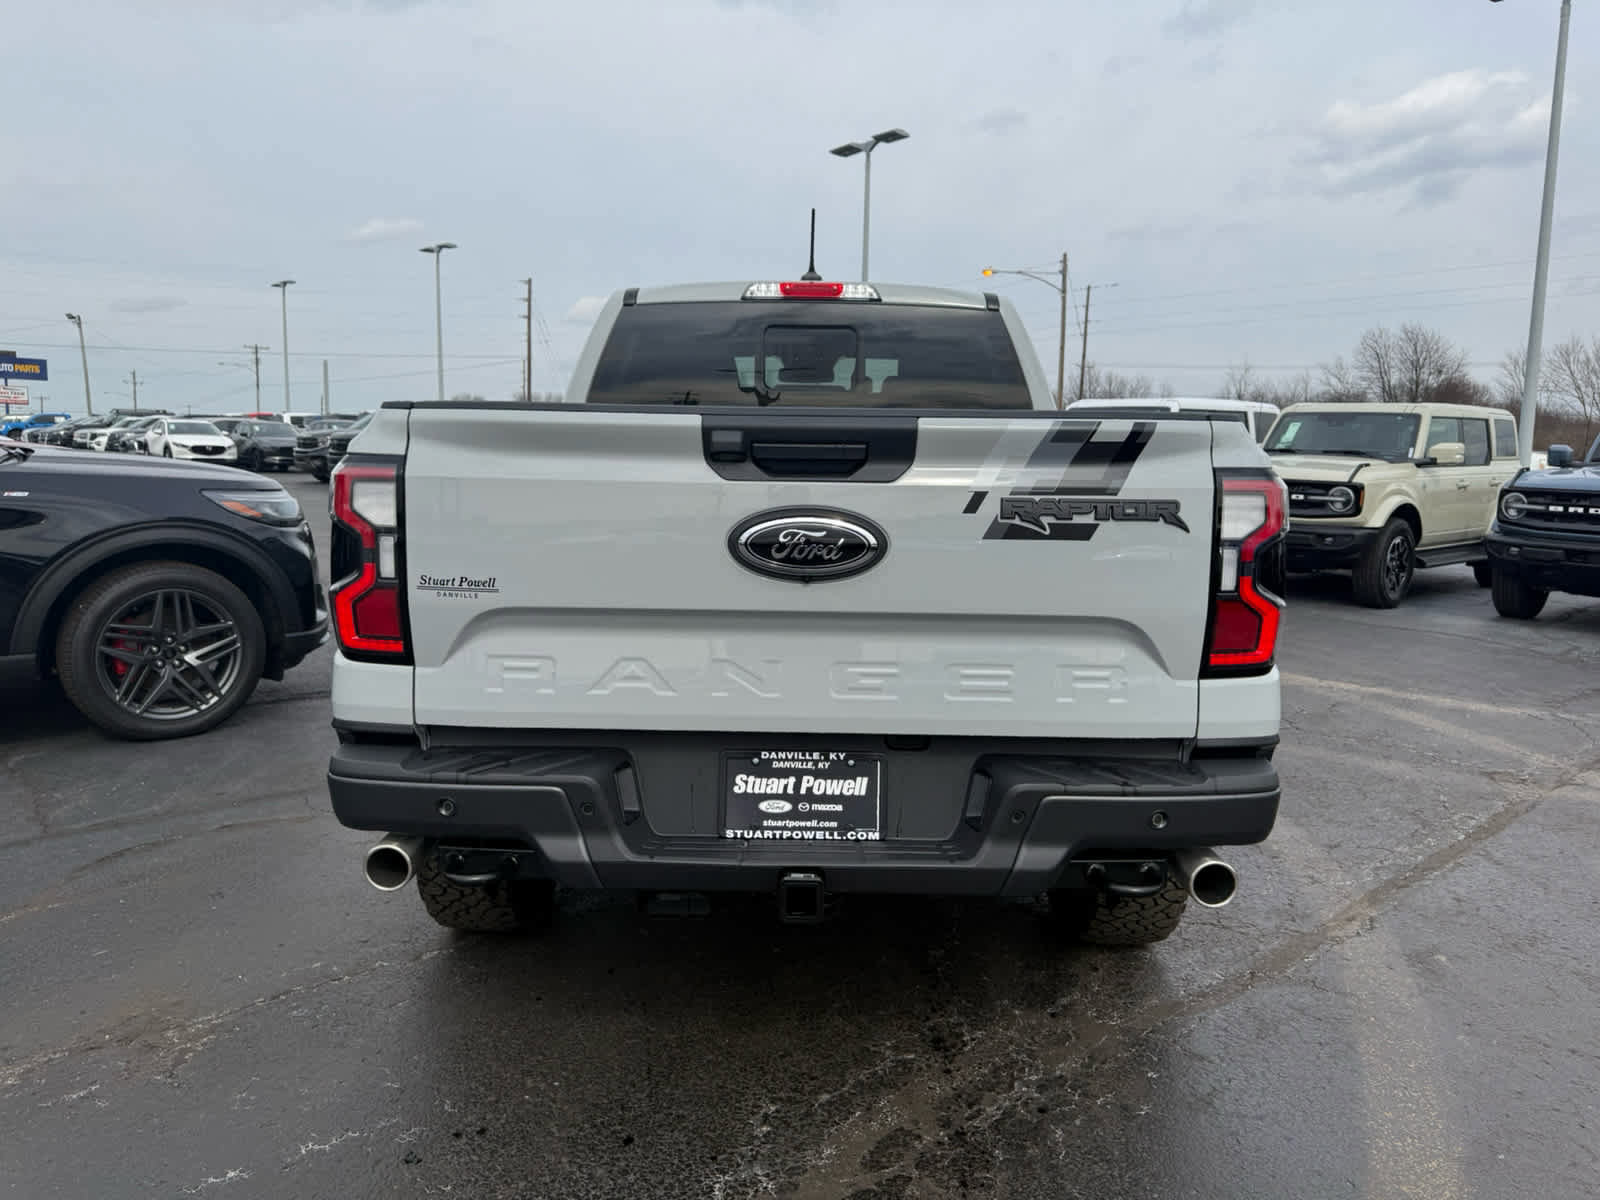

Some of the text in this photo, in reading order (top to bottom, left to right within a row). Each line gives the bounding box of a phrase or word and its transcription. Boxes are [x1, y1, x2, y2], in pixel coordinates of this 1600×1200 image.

[0, 363, 40, 373] UTO PARTS
[1000, 497, 1190, 533] RAPTOR
[771, 528, 845, 561] Ford
[419, 575, 497, 588] Stuart Powell
[436, 591, 479, 600] DANVILLE
[484, 653, 1128, 702] RANGER
[760, 751, 846, 761] DANVILLE, KY
[772, 761, 831, 770] DANVILLE, KY
[733, 773, 869, 796] Stuart Powell
[762, 819, 838, 828] stuartpowell.com
[725, 829, 880, 841] STUARTPOWELL.COM
